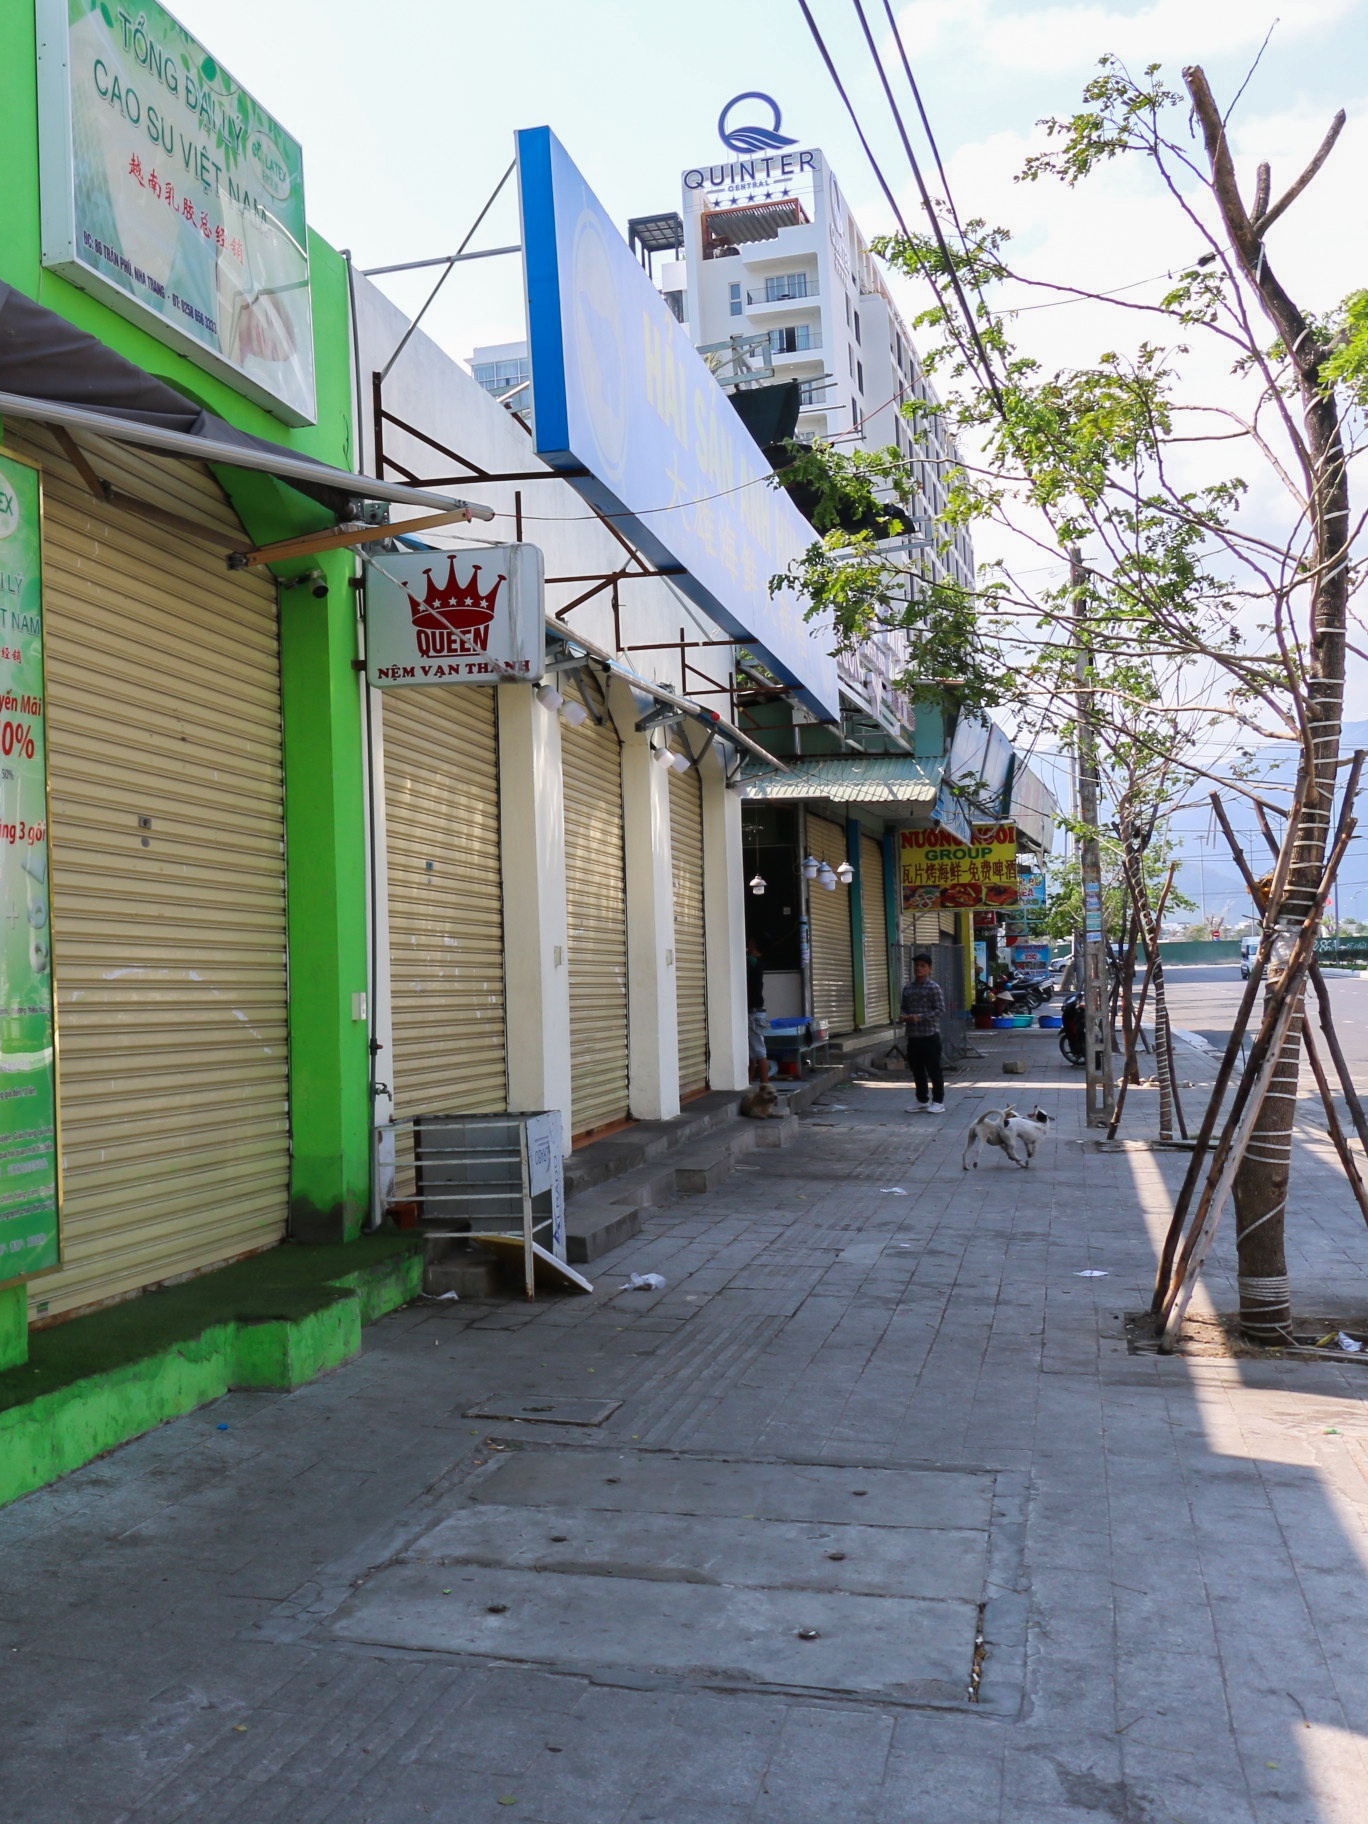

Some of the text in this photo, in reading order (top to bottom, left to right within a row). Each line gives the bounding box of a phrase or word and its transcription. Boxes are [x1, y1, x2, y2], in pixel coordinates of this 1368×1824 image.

[118, 11, 243, 153] TỔNG ĐẠI LÝ
[93, 58, 141, 127] CAO
[147, 105, 174, 156] SU
[179, 132, 223, 197] VIỆT
[228, 175, 268, 223] NAM
[684, 151, 817, 189] QUINTER
[728, 180, 770, 192] CENTRAL
[129, 152, 244, 266] 越南乳胶总经销
[134, 266, 146, 287] NHA
[147, 275, 165, 299] TRANG
[8, 572, 23, 594] LÝ
[11, 613, 41, 636] NAM
[416, 624, 490, 658] QUEEN
[377, 658, 530, 681] NỆM VẠN THNH
[20, 695, 42, 716] Mãi
[18, 821, 25, 840] 3
[28, 819, 46, 846] gối
[924, 847, 993, 861] GROUP
